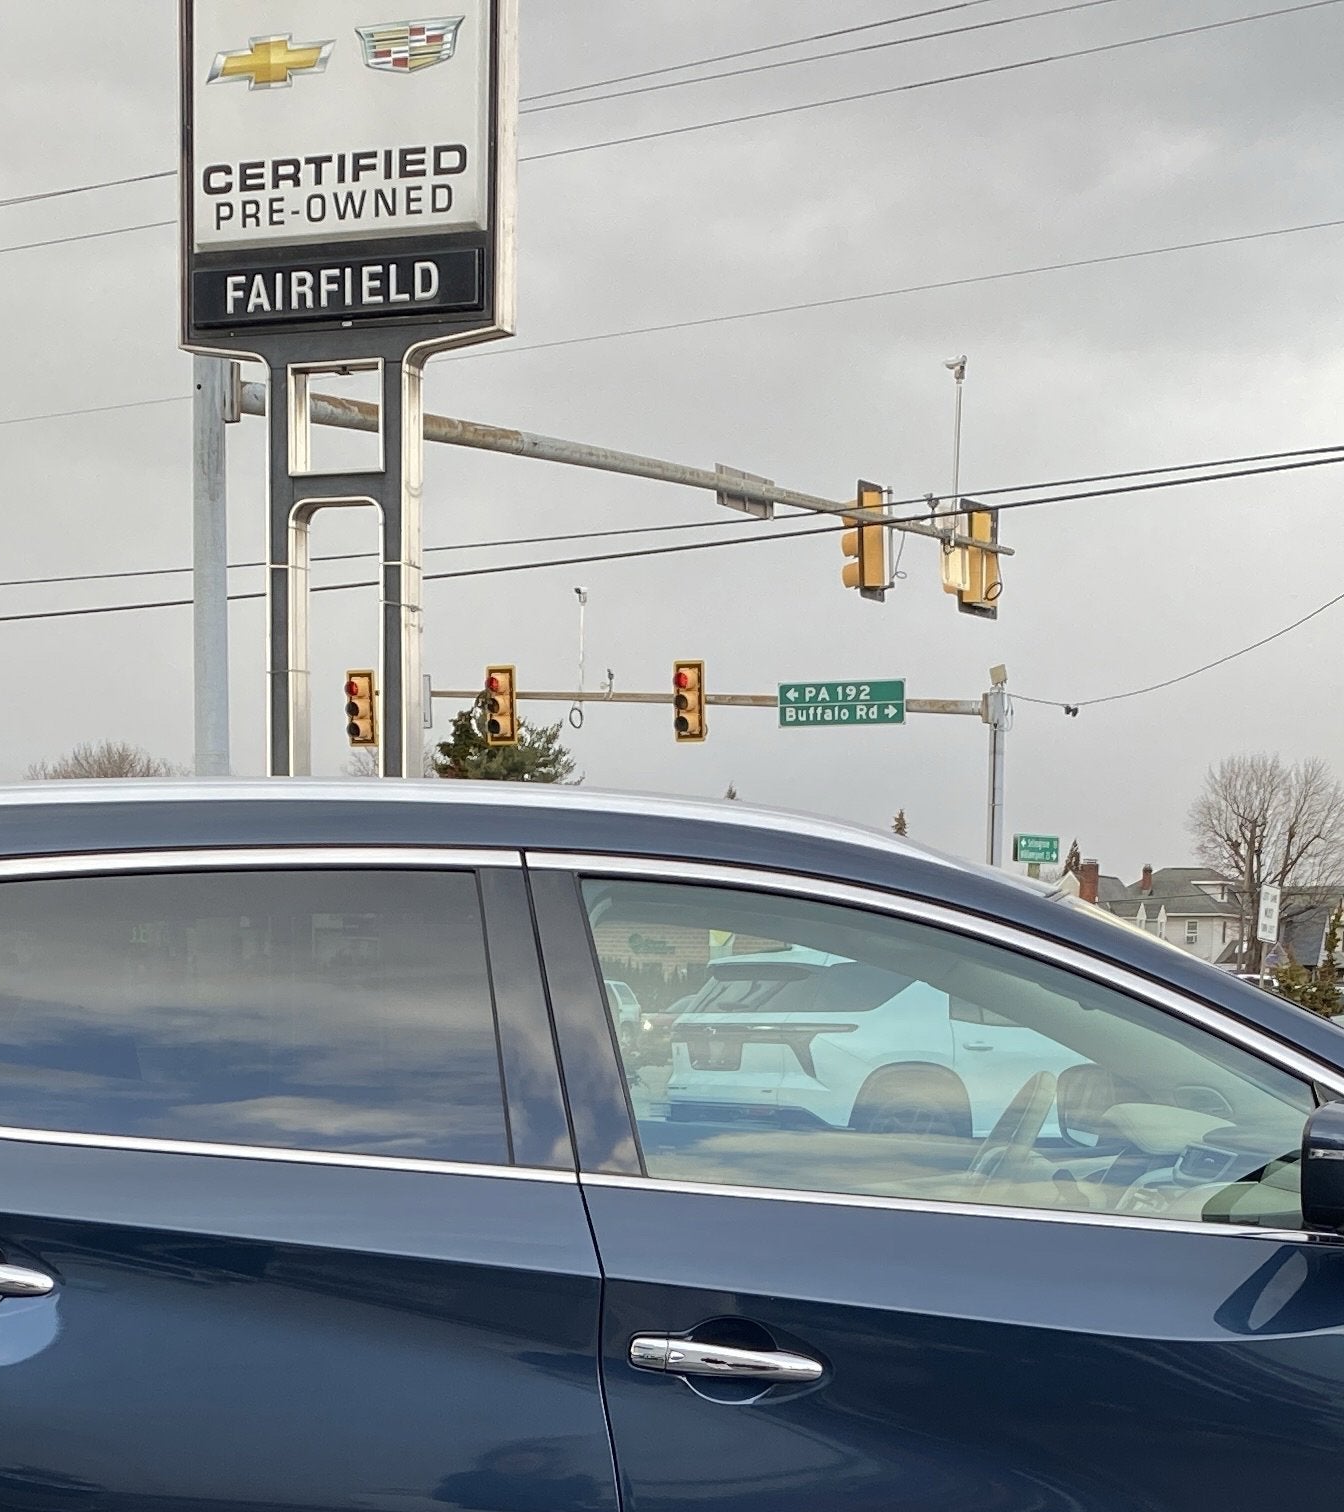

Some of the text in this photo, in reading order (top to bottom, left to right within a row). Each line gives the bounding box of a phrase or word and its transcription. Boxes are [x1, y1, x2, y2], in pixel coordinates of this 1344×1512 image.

[202, 143, 468, 195] CERTIFIED
[215, 183, 454, 231] PRE-OWNED
[226, 261, 440, 315] FAIRFIELD
[785, 704, 878, 722] Buffalo Rd
[804, 685, 871, 702] PA 192
